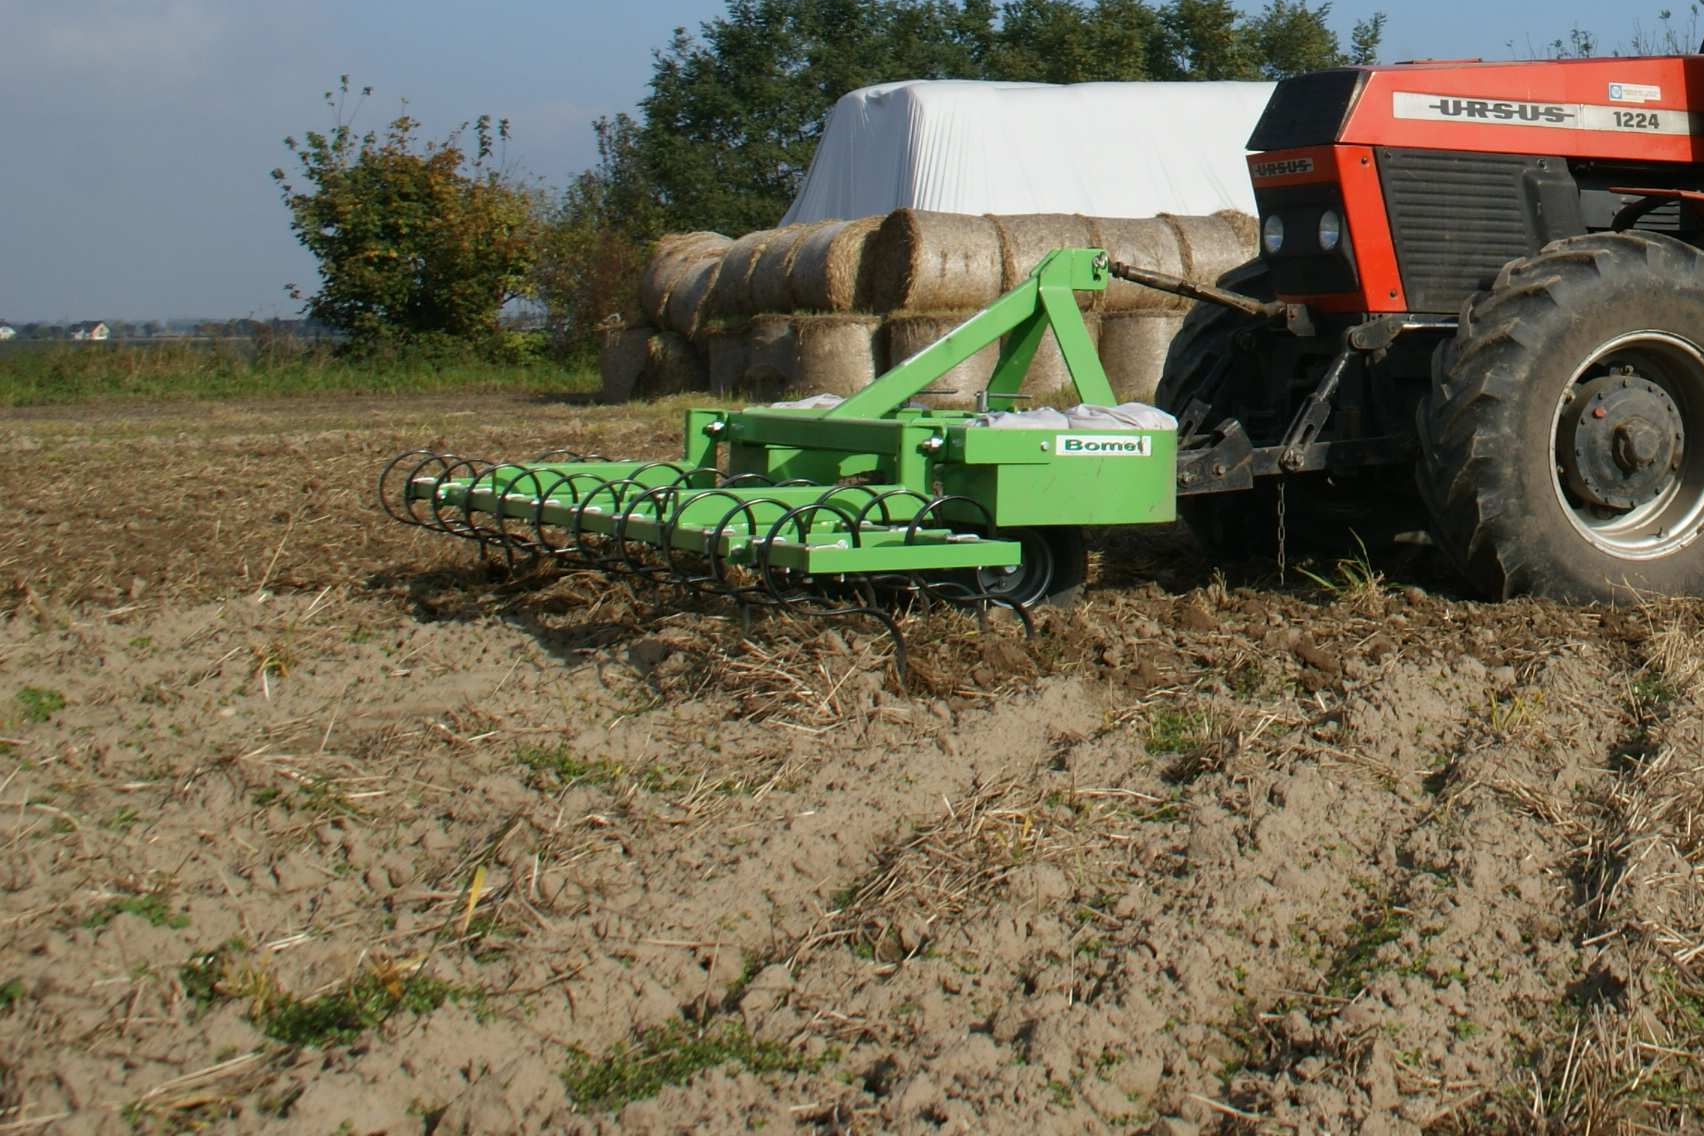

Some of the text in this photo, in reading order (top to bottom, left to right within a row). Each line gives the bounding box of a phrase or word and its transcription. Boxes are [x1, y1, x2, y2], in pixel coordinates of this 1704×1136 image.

[1436, 98, 1660, 129] URSUS 1224
[1254, 159, 1309, 177] URSUS
